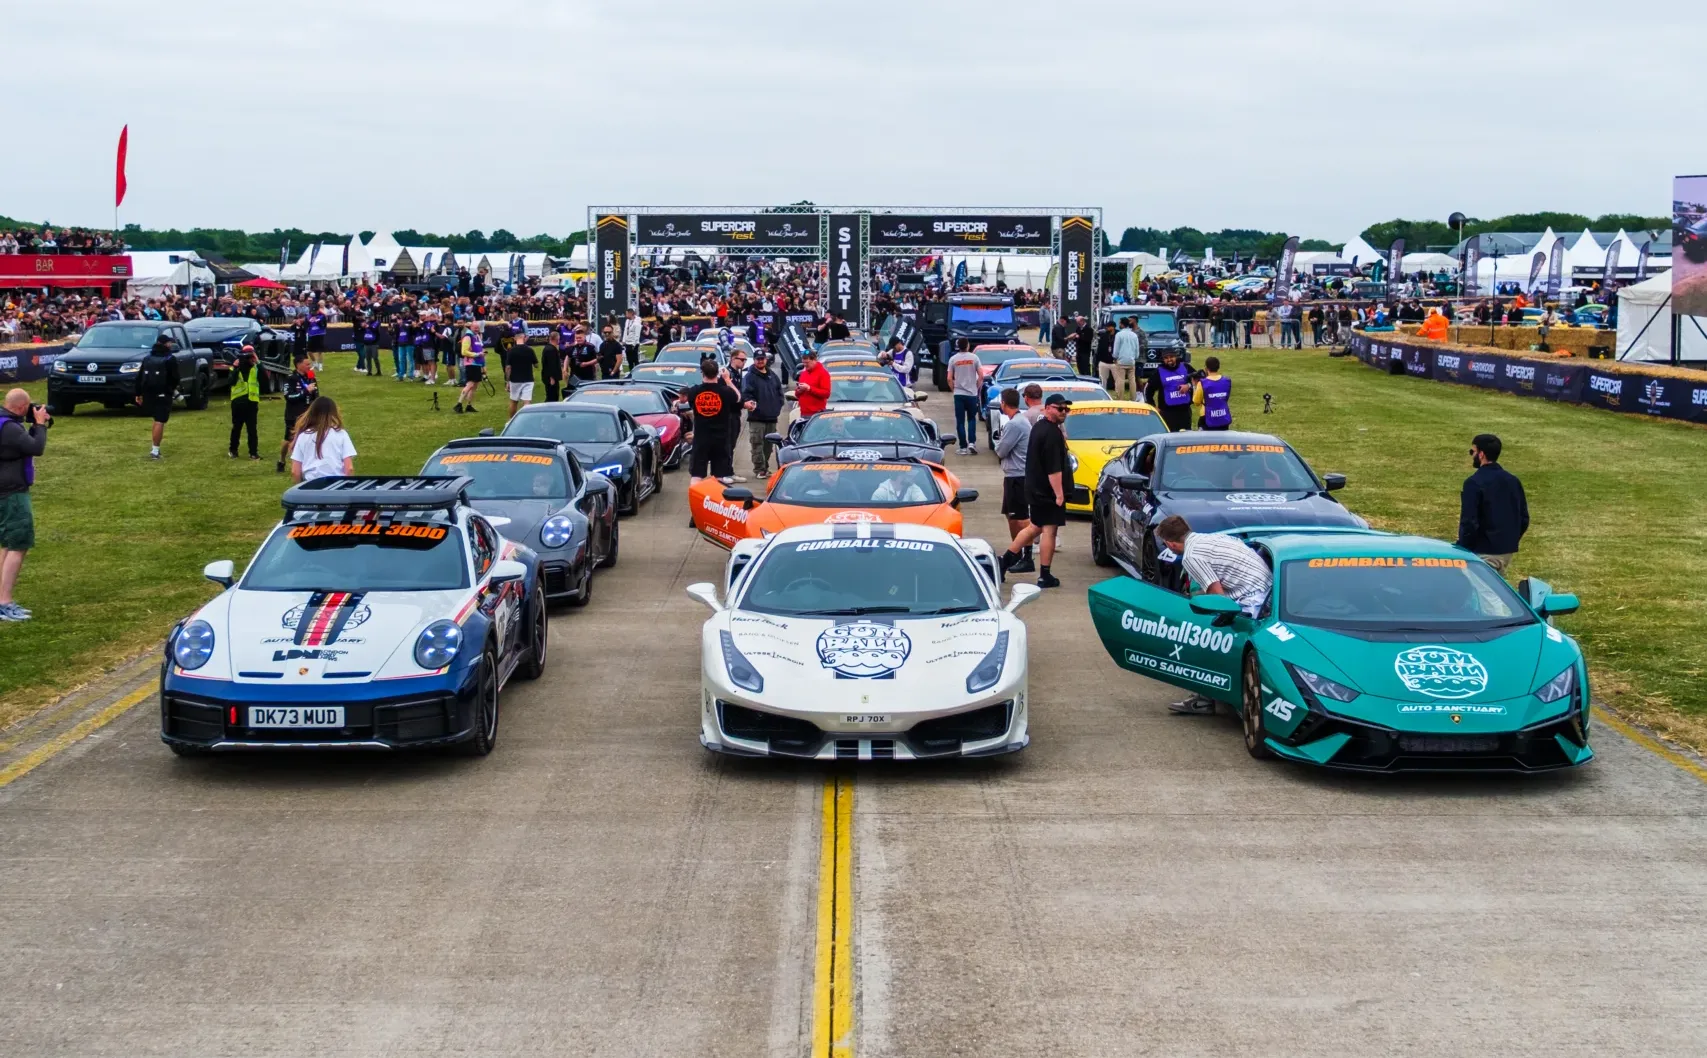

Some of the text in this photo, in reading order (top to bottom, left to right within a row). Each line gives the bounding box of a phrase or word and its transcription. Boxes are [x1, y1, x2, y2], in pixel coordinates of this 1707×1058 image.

[701, 222, 756, 232] SUPERCAR
[934, 222, 988, 232] SUPERCAR
[722, 232, 756, 240] fest
[36, 259, 54, 272] BAR
[838, 227, 852, 310] START
[604, 250, 614, 299] SUPERCAR
[1068, 251, 1078, 300] SUPERCAR
[1438, 354, 1460, 368] SUPERCAR
[1506, 364, 1535, 380] SUPERCAR
[1590, 375, 1622, 394] SUPERCAR
[1600, 394, 1620, 406] fest
[1070, 407, 1150, 416] GUMBALL 3000
[1210, 409, 1226, 417] MEDIA
[1176, 444, 1284, 454] GUMBALL 3000
[440, 454, 552, 466] GUMBALL 3000
[703, 495, 748, 524] Gumball300
[287, 524, 446, 540] GUMBALL 3000
[796, 540, 934, 552] GUMBALL 3000
[1308, 558, 1468, 568] GUMBALL 3000
[941, 618, 969, 628] Hard
[1122, 610, 1234, 654] Gumball3000
[272, 650, 321, 661] LDN
[1128, 652, 1228, 687] AUTO SANCTUARY
[1265, 698, 1297, 722] AS
[1435, 705, 1504, 714] SANCTUARY
[255, 709, 336, 724] DK73 MUD
